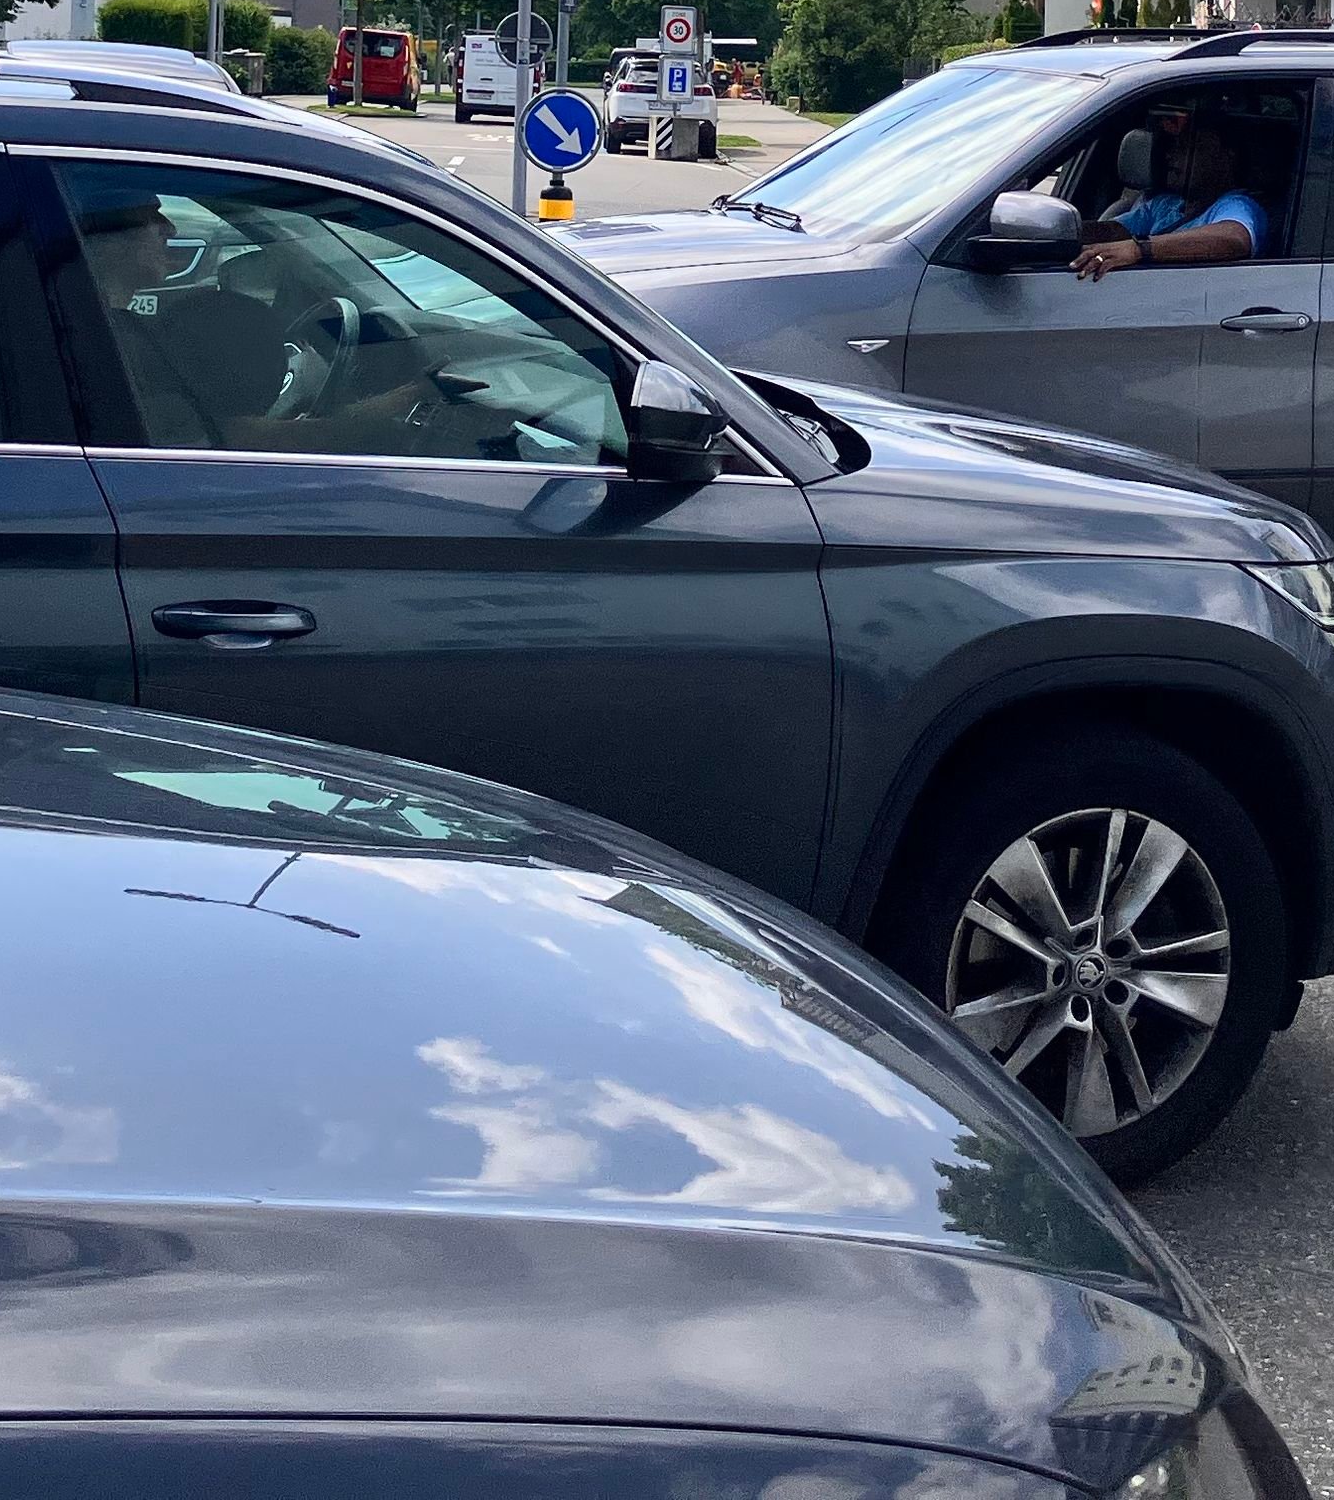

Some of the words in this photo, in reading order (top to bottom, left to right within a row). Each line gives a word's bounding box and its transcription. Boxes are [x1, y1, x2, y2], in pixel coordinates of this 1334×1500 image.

[673, 26, 683, 36] 30
[674, 69, 683, 83] P
[131, 299, 155, 313] 245
